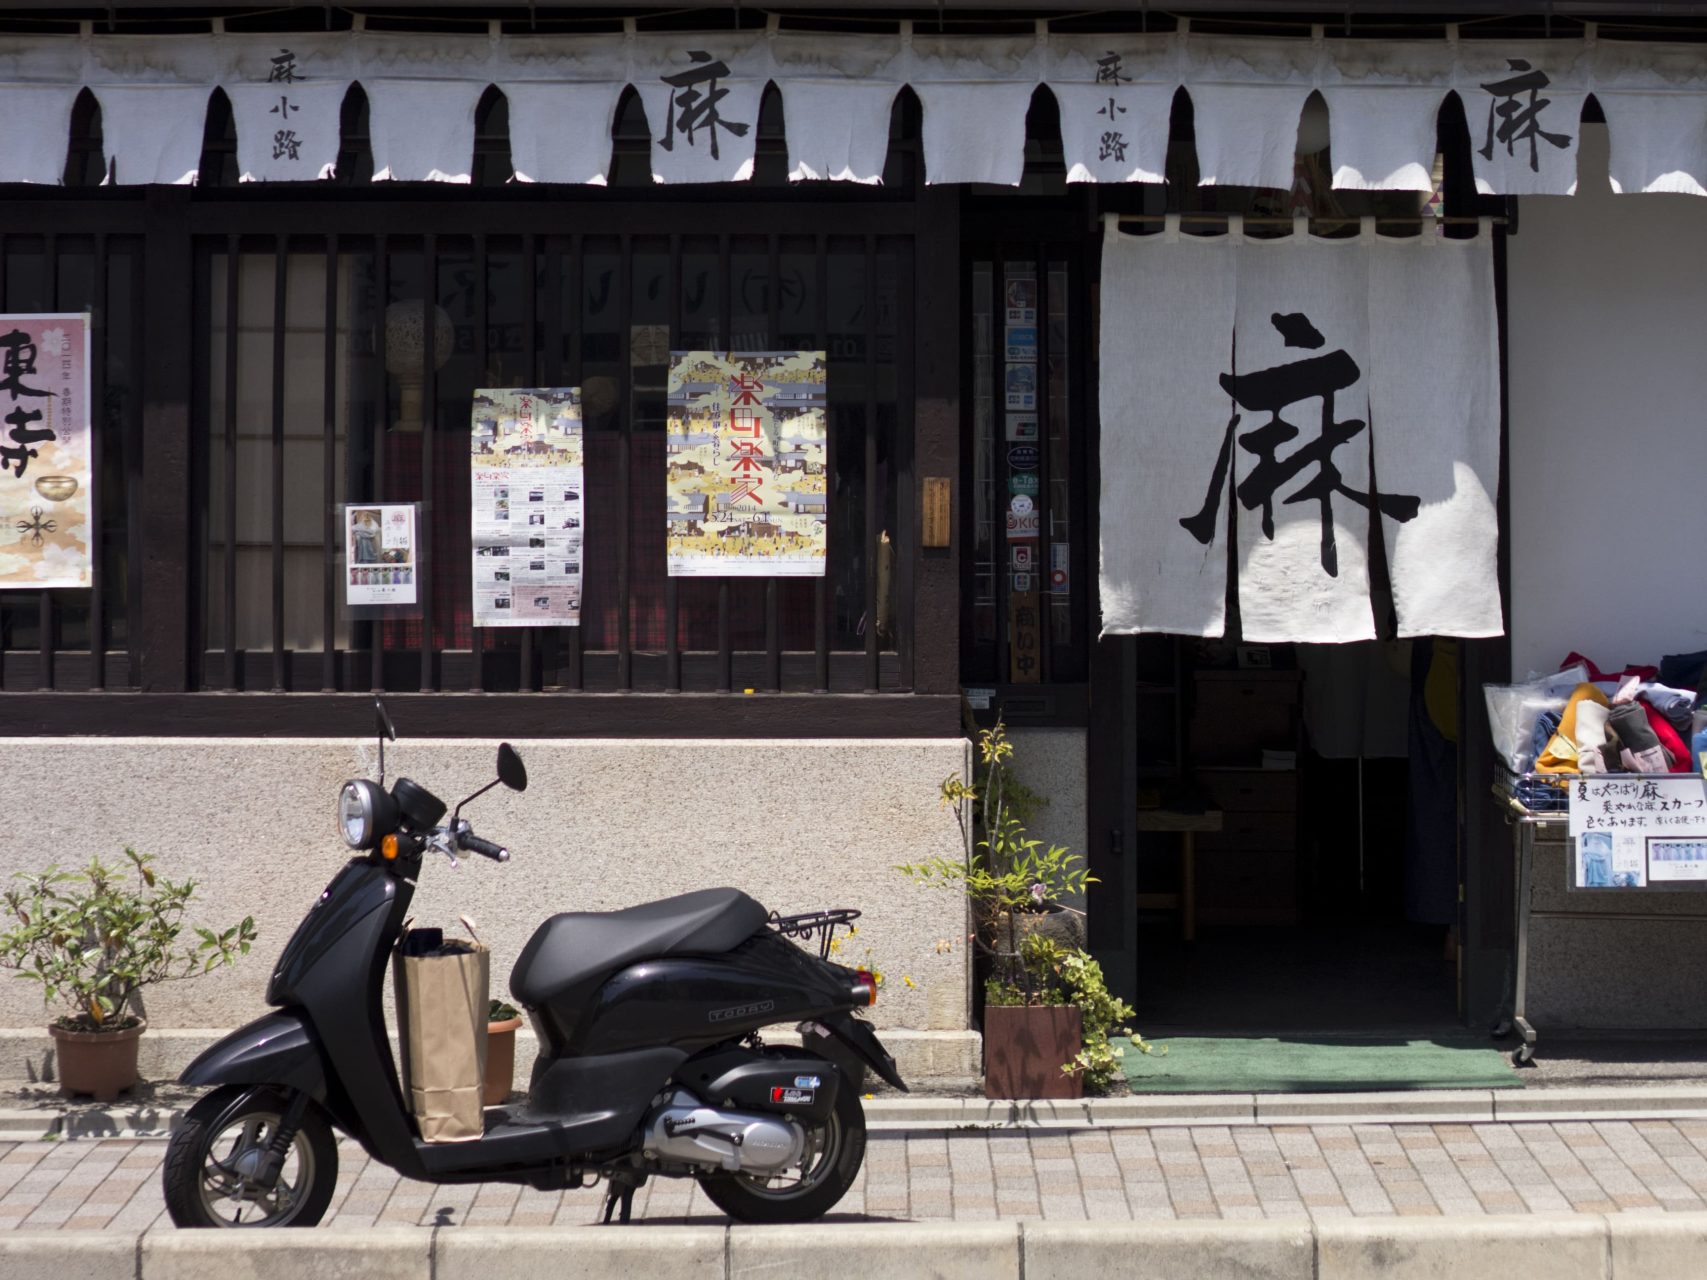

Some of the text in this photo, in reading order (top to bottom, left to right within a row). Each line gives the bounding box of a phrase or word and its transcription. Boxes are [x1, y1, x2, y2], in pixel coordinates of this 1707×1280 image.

[266, 47, 306, 162] 麻小路
[657, 50, 752, 162] 麻
[1094, 50, 1133, 164] 麻小路
[1478, 58, 1572, 174] 麻
[730, 372, 764, 506] 楽町楽家
[1178, 311, 1422, 579] 麻
[1016, 605, 1035, 676] 商い中
